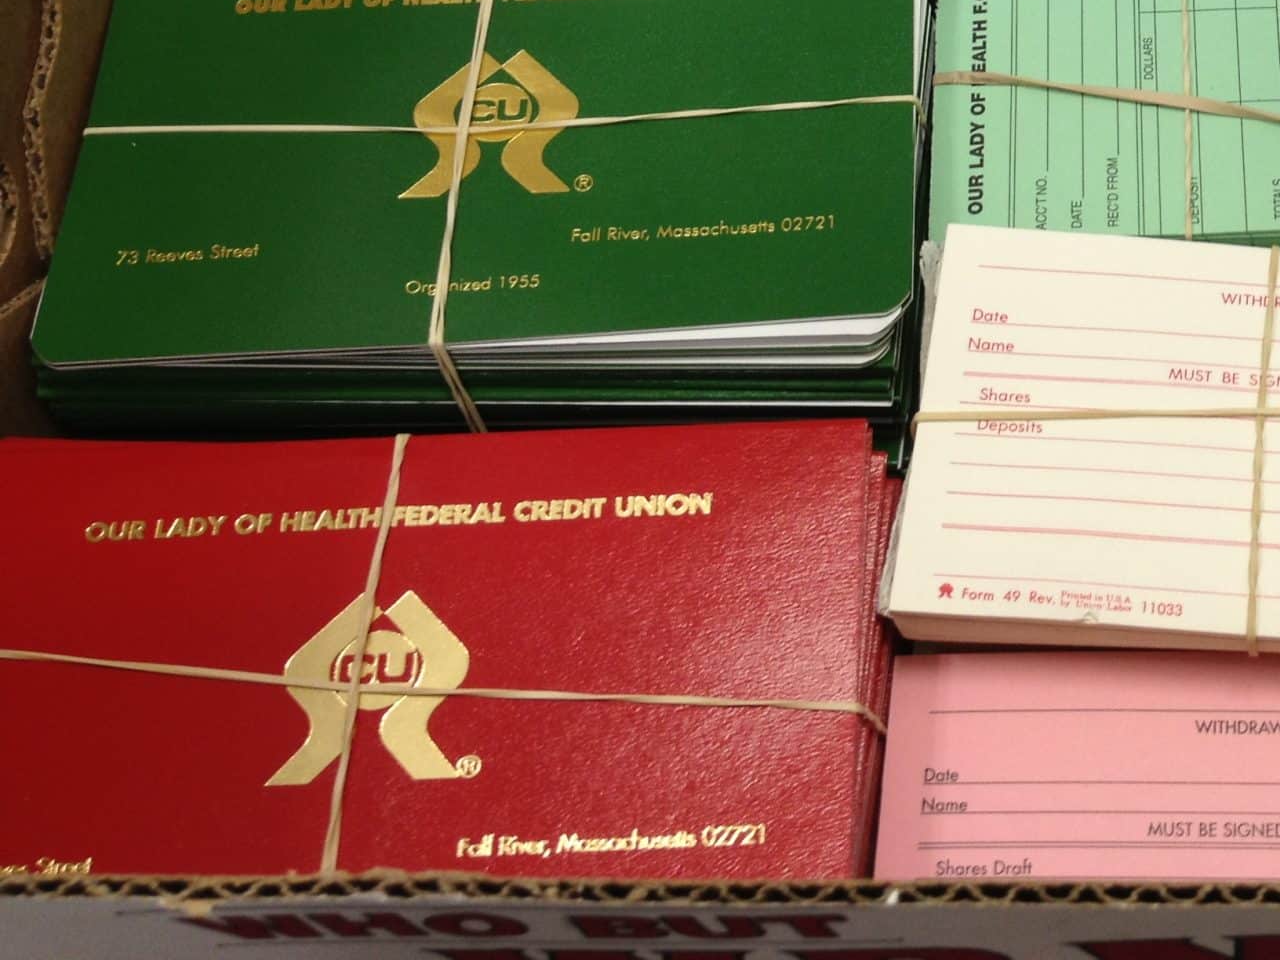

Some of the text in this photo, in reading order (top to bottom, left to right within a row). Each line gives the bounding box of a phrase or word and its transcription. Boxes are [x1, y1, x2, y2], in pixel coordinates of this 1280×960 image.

[1143, 38, 1154, 80] DOLLARS
[970, 93, 986, 116] OF
[969, 122, 986, 169] LADY
[968, 176, 984, 216] OUR
[1036, 175, 1048, 196] NO.
[1107, 157, 1120, 228] REC'D FROM
[1072, 200, 1082, 228] DATE
[571, 214, 836, 244] Fall River, Massachusetts 02721
[115, 242, 260, 266] 73 Reeves Street
[405, 274, 541, 297] Orgnized 1955
[972, 308, 1008, 325] Date
[967, 338, 1015, 354] Name
[1168, 368, 1212, 382] MUST
[1222, 372, 1240, 386] BE
[979, 387, 1032, 405] Shares
[976, 418, 1043, 436] Deposits
[84, 491, 714, 544] OUR LADY OF HEALTH FEDERAL CREDIT UNION
[961, 586, 1184, 617] Form 49 11033
[922, 766, 958, 784] Date
[920, 797, 968, 814] Name
[1148, 821, 1192, 838] MUST
[1198, 822, 1218, 838] BE
[457, 825, 766, 858] Fall River, Massachusetts 02721
[936, 858, 1032, 876] Shares Draft
[178, 911, 848, 942] WHO BUT
